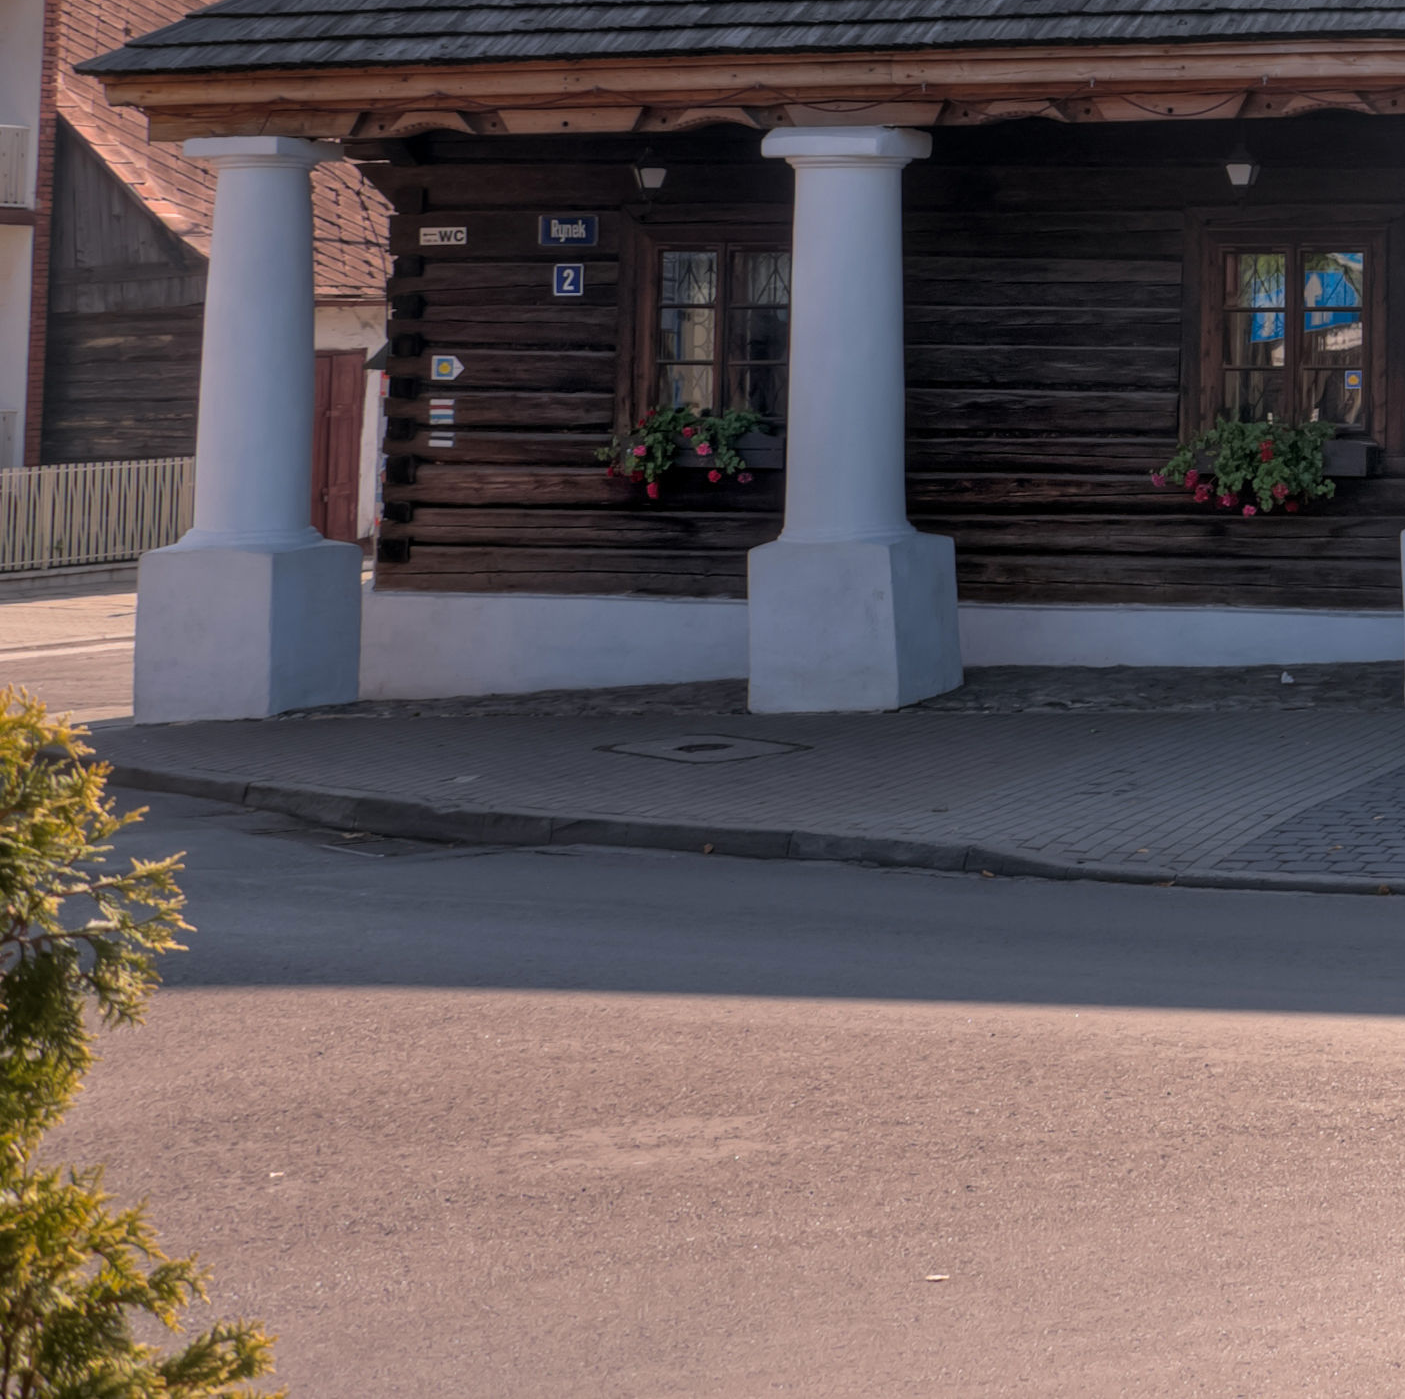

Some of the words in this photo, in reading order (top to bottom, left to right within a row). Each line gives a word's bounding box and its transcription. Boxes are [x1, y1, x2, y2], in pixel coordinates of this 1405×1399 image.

[438, 229, 464, 242] WC
[550, 219, 586, 242] Rynek
[562, 269, 575, 290] 2
